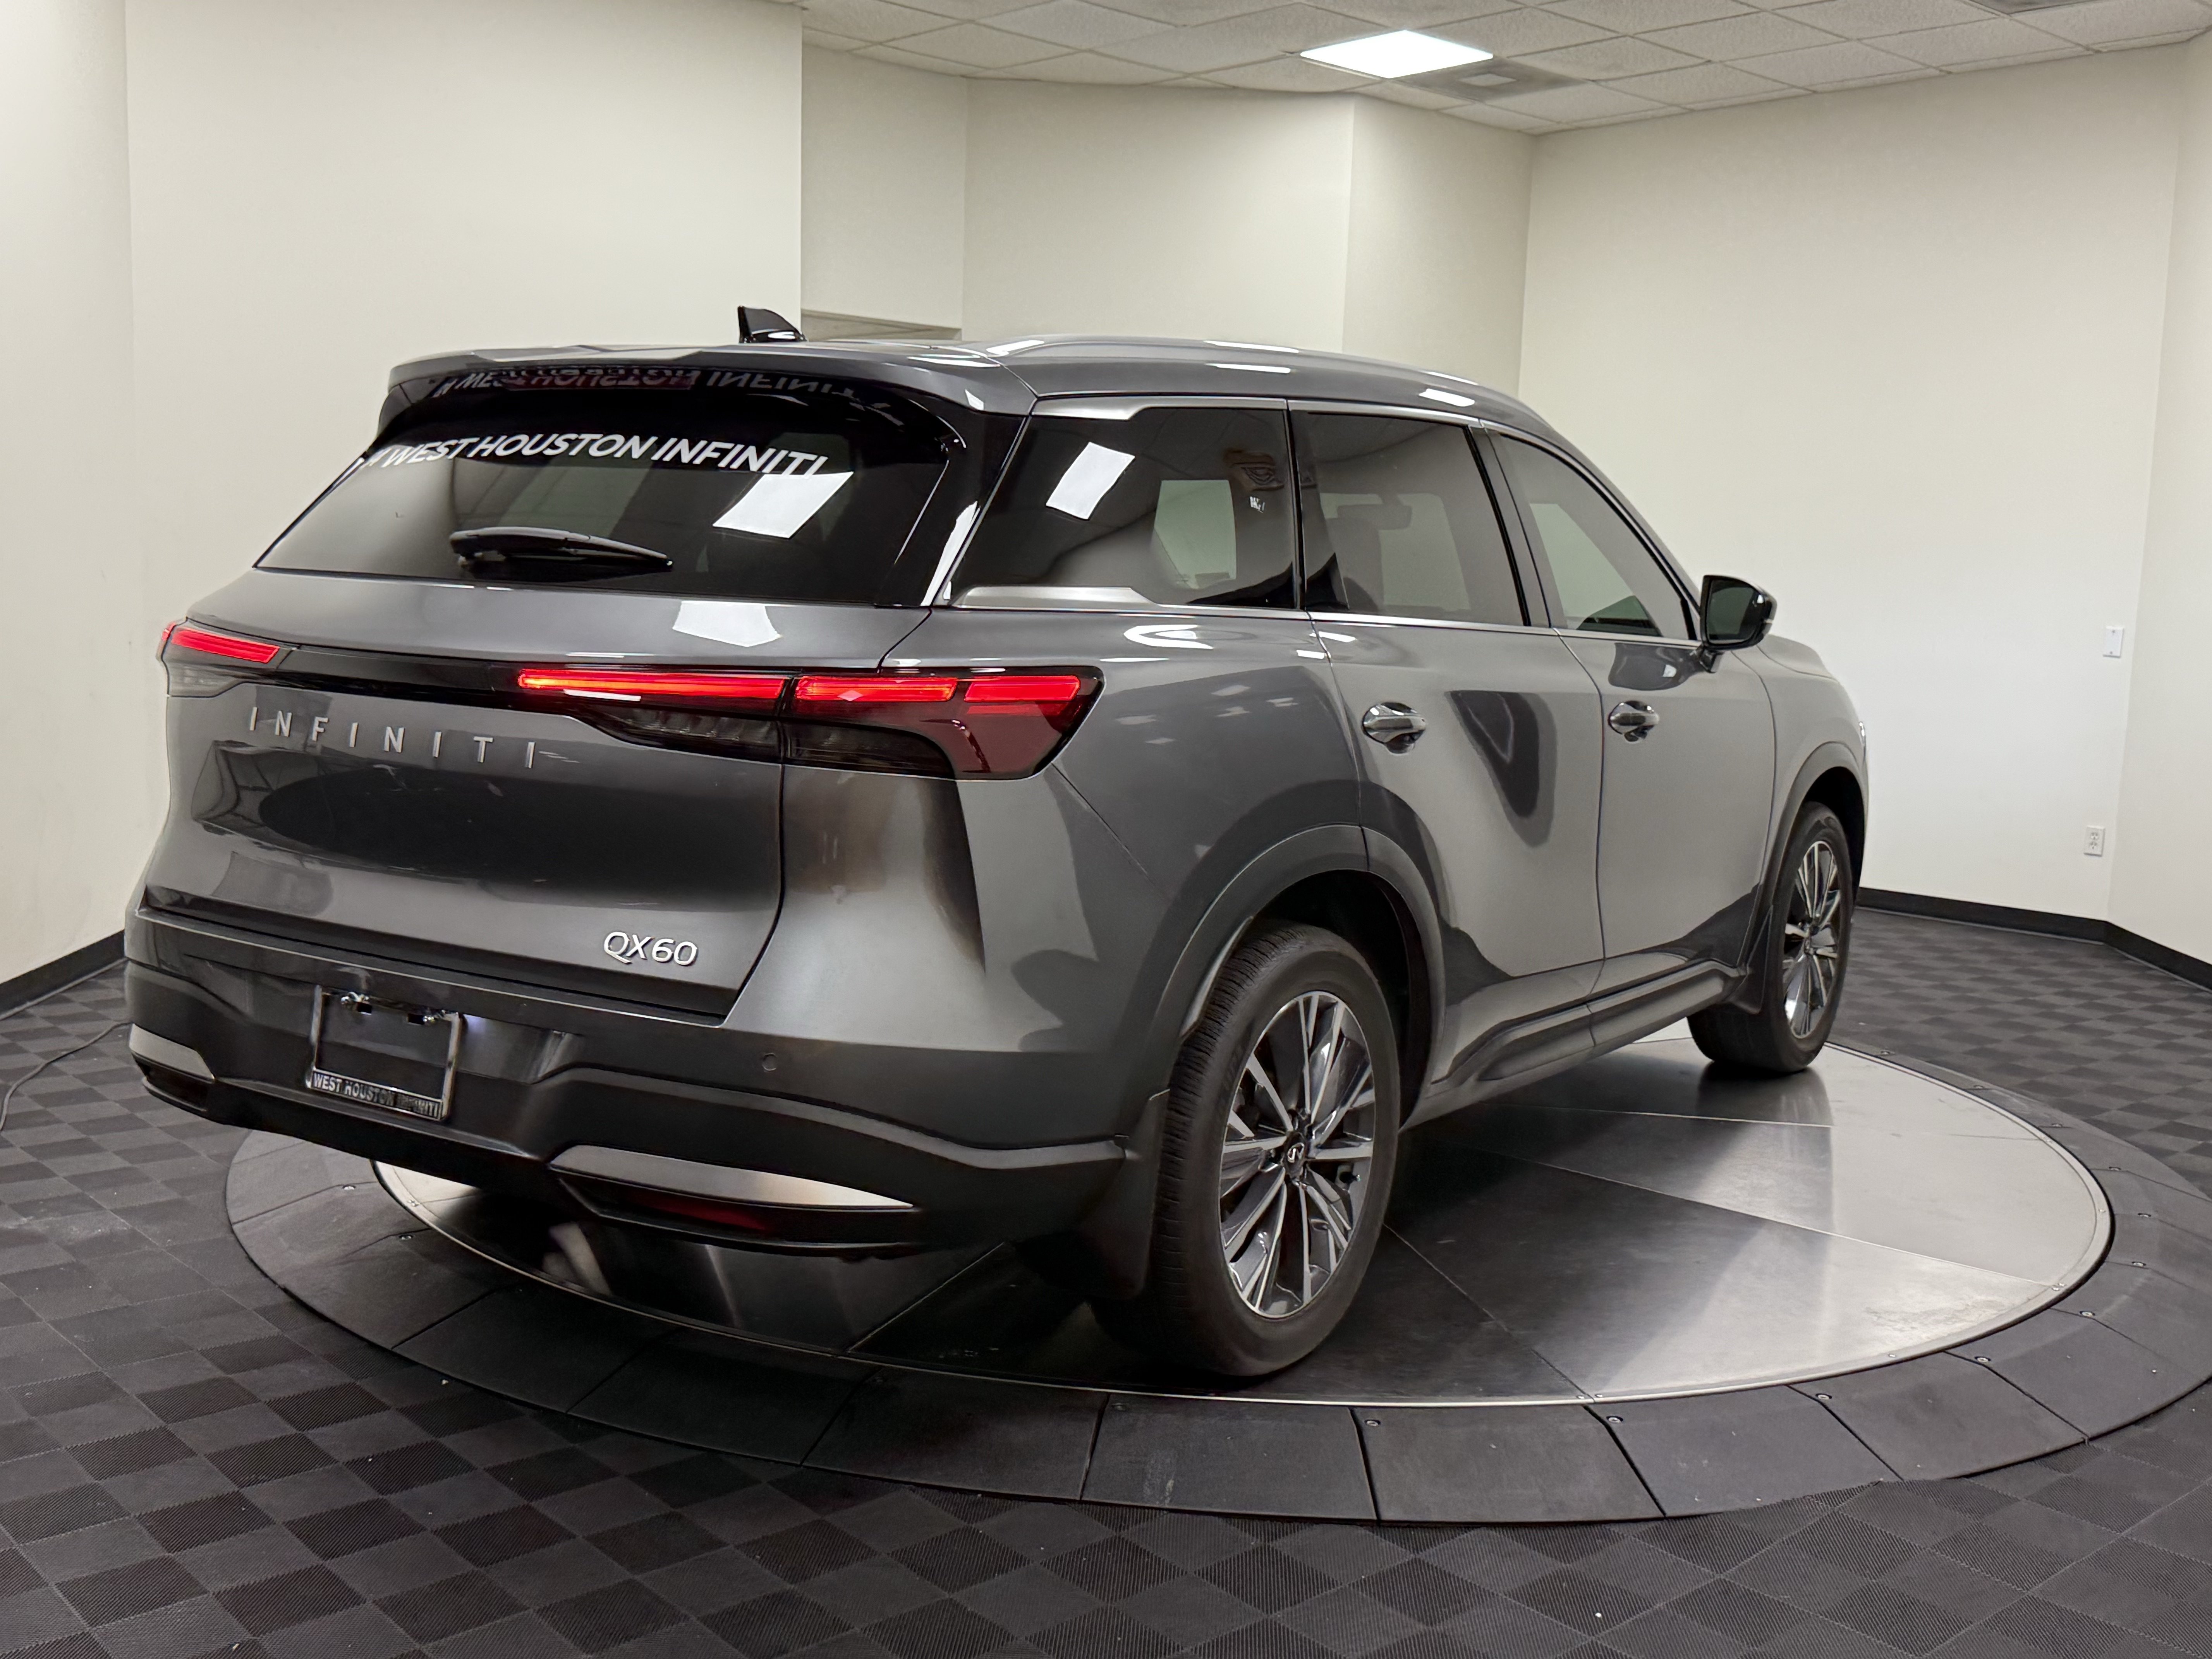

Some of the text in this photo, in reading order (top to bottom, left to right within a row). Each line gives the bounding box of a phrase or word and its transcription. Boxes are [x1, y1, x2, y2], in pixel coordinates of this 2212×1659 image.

[381, 433, 828, 479] WEST HOUSTON INFINITI
[250, 707, 535, 768] INFINITI
[604, 932, 697, 966] QX60
[314, 1072, 342, 1093] WEST
[344, 1080, 395, 1106] HOUSTON
